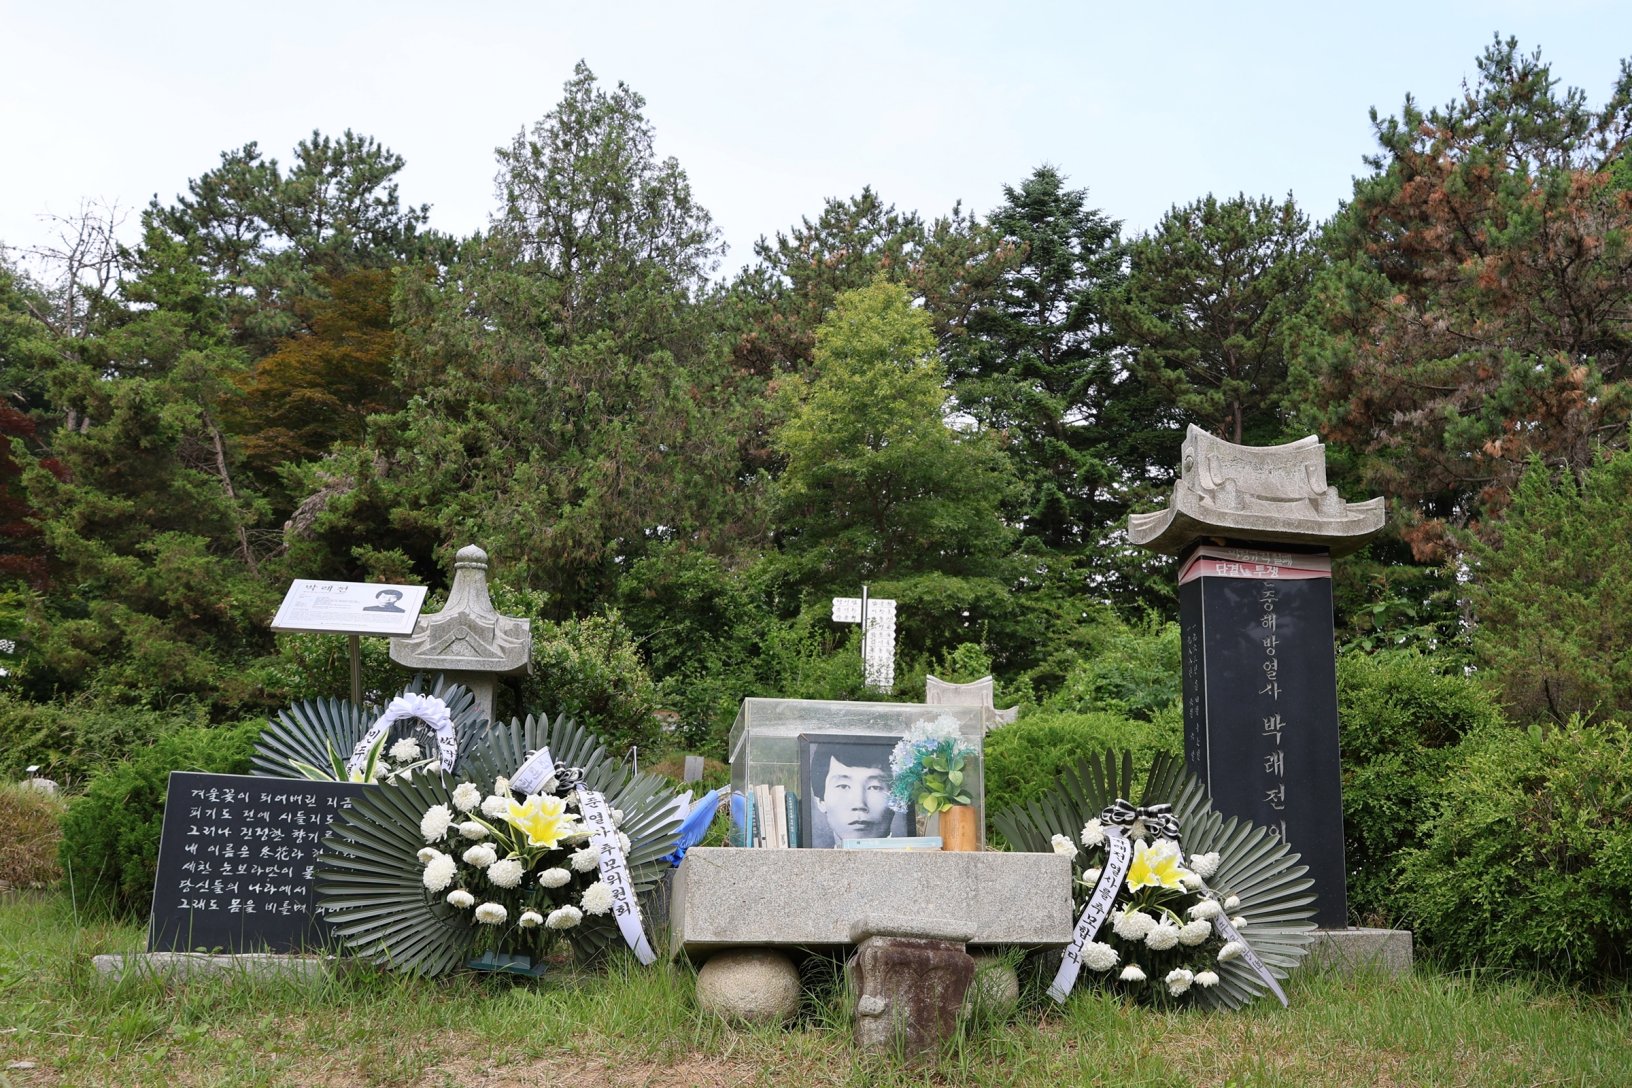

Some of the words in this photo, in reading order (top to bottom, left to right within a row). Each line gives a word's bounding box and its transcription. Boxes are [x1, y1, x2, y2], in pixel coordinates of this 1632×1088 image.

[1215, 562, 1240, 577] 단결
[1253, 564, 1279, 578] 투쟁
[1258, 581, 1282, 700] 중해방열사
[260, 793, 317, 808] 되어버린
[327, 796, 352, 809] 지금
[189, 806, 233, 820] 피기도
[243, 808, 270, 823] 전에
[279, 811, 335, 825] 시들지도
[187, 825, 232, 838] 그러나
[240, 827, 285, 842] 진정한
[184, 843, 199, 856] 내
[207, 843, 250, 858] 이름은
[181, 861, 213, 875] 세찬
[220, 861, 294, 878] 눈보라만이
[179, 878, 239, 894] 당신들의
[248, 882, 306, 896] 나라에서
[177, 898, 220, 911] 그래도
[228, 898, 257, 914] 몸을
